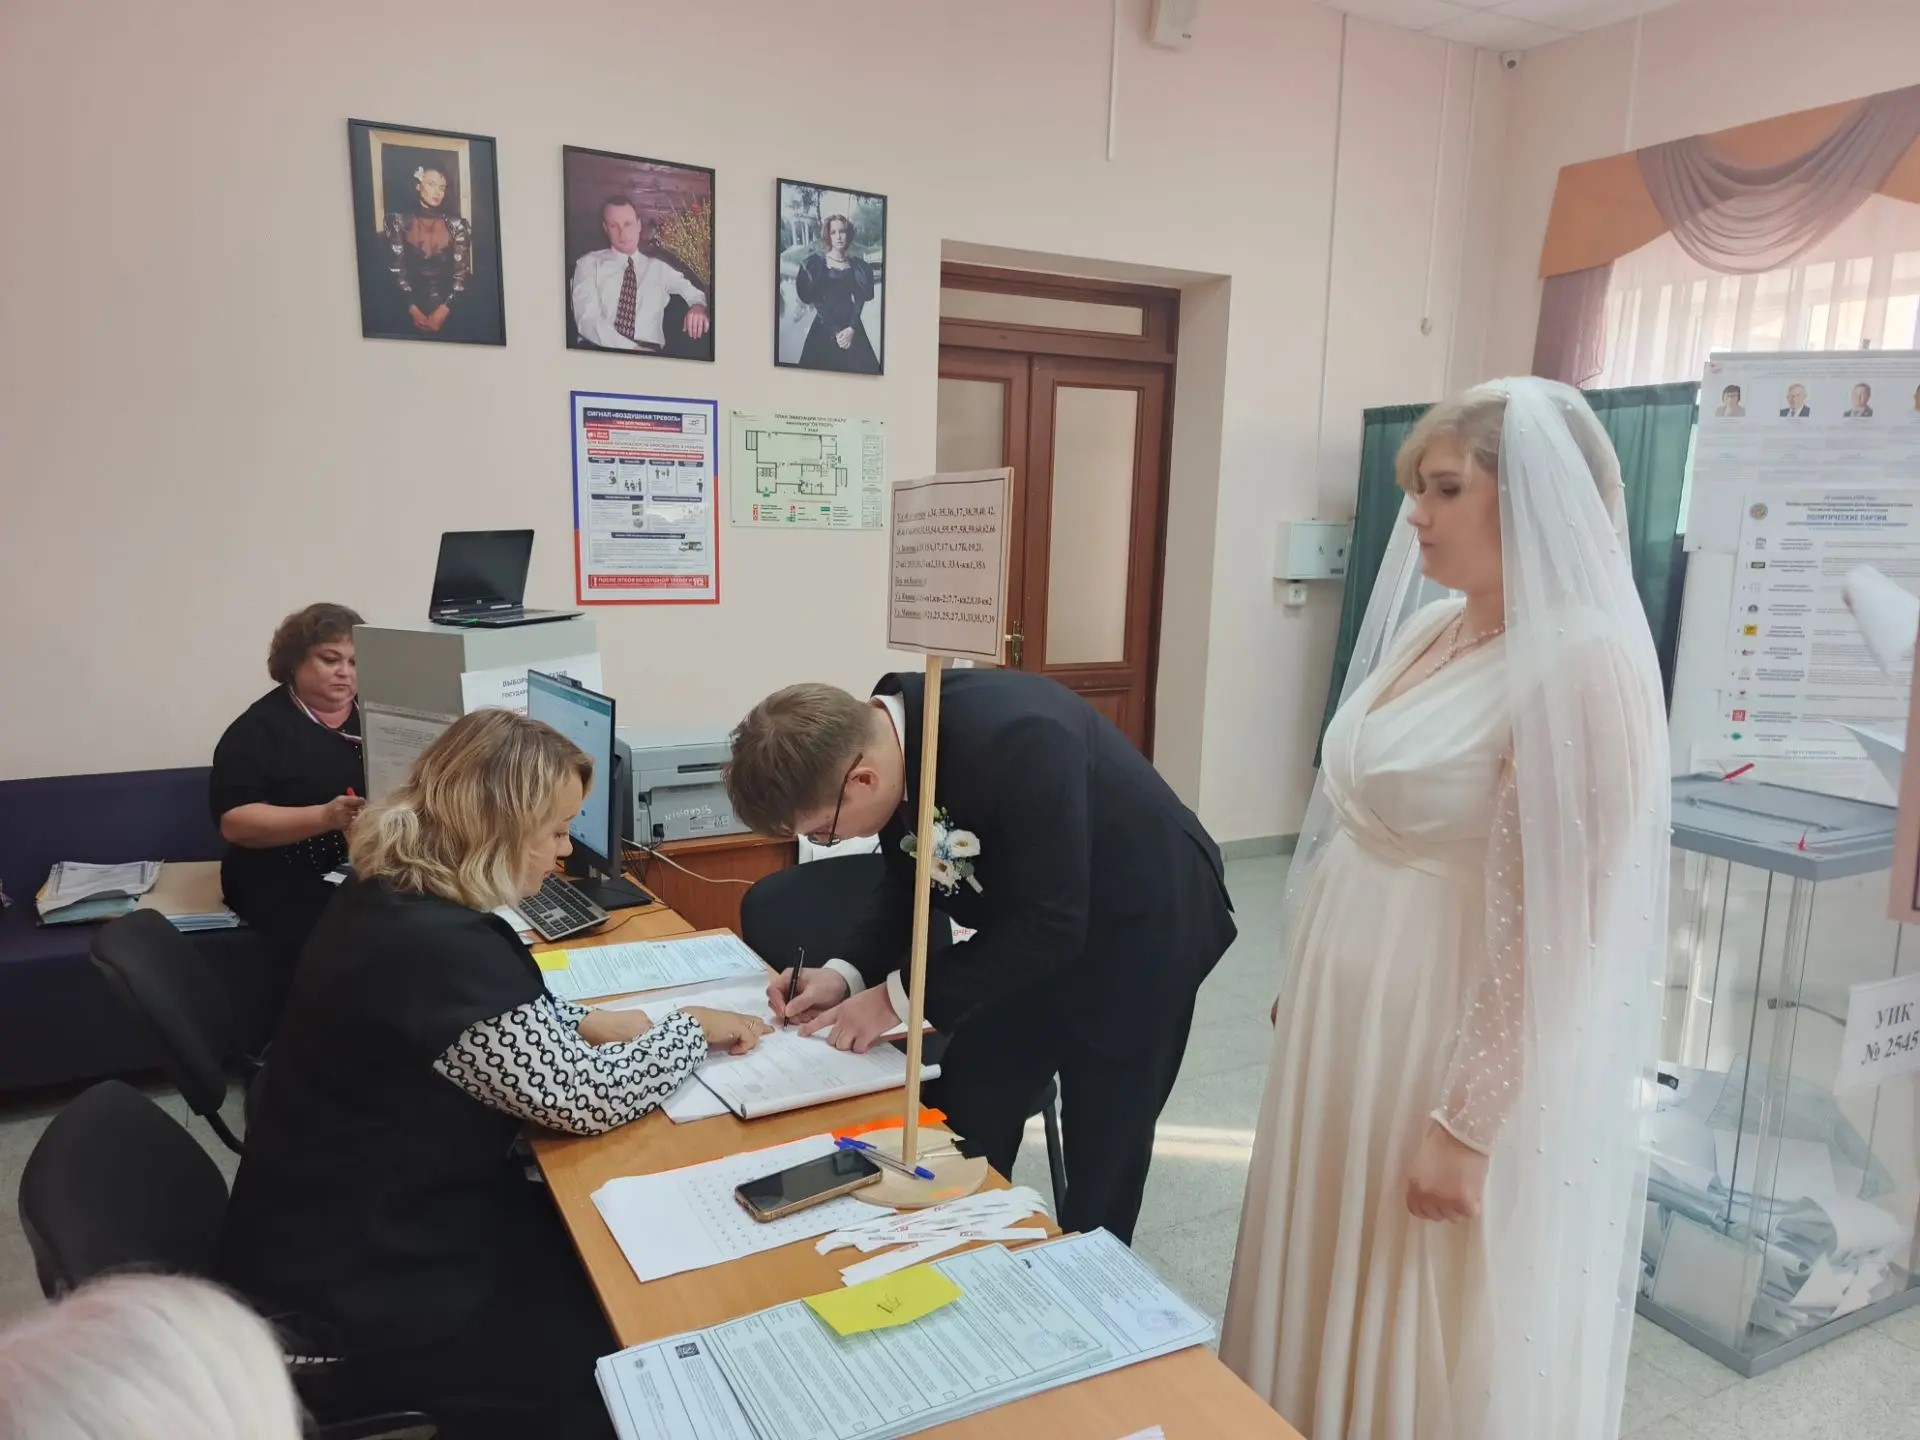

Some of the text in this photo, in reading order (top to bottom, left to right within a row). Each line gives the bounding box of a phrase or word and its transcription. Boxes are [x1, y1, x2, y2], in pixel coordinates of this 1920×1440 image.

[1875, 1003, 1914, 1029] УИК
[1861, 1030, 1920, 1065] № 2545
